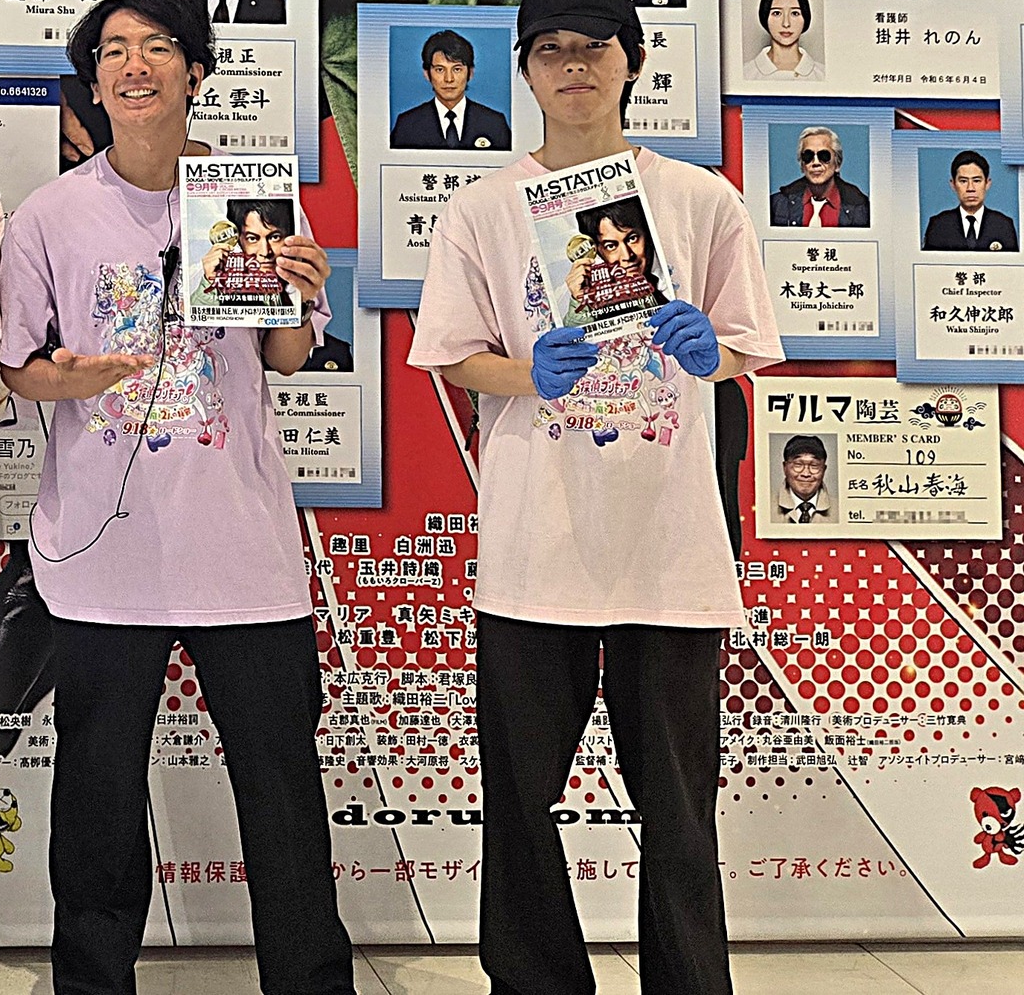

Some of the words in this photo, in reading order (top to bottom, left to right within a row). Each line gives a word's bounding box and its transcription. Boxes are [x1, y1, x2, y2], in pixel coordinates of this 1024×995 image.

[26, 4, 55, 14] Miura
[56, 5, 75, 15] Shu
[875, 12, 908, 23] 看護師
[876, 28, 911, 45] 掛井
[924, 29, 981, 45] れのん
[214, 67, 283, 77] Commissioner
[873, 74, 912, 84] 交付年月日
[652, 72, 673, 92] 輝
[229, 88, 271, 109] 雲斗
[634, 96, 668, 105] Hikaru
[193, 112, 230, 121] Kitaoka
[232, 112, 258, 121] Ikuto
[186, 163, 293, 178] M-STATION
[525, 159, 632, 201] M-STATION
[399, 193, 436, 202] Assistant
[806, 247, 838, 262] 警視
[791, 264, 852, 274] Superintendent
[954, 271, 986, 286] 警部
[779, 280, 865, 299] 木島丈一郎
[941, 287, 964, 297] Chief
[966, 288, 1002, 298] Inspector
[791, 301, 817, 311] Kijima
[818, 301, 854, 311] Johichiro
[929, 305, 1014, 323] 和久伸次郎
[946, 325, 968, 333] Waku
[969, 325, 1000, 336] Shinjiro
[277, 392, 329, 407] 警視監
[287, 409, 346, 418] Commissioner
[566, 416, 594, 430] 9.18
[305, 427, 341, 445] 仁美
[910, 435, 941, 444] CARD
[300, 447, 330, 456] Hitomi
[847, 450, 866, 460] No.
[906, 449, 936, 465] 109
[848, 479, 868, 490] 氏名
[872, 473, 968, 496] 秋山春海
[848, 510, 866, 520] tel.
[332, 537, 369, 553] 趣里
[397, 538, 454, 554] 白洲迅
[359, 561, 439, 576] 玉井詩織
[358, 577, 442, 586] (ももいろクローバーZ)
[315, 607, 370, 622] マリア
[397, 607, 474, 622] 真矢ミキ
[338, 629, 396, 645] 松重豊
[732, 631, 829, 646] 北村総一朗
